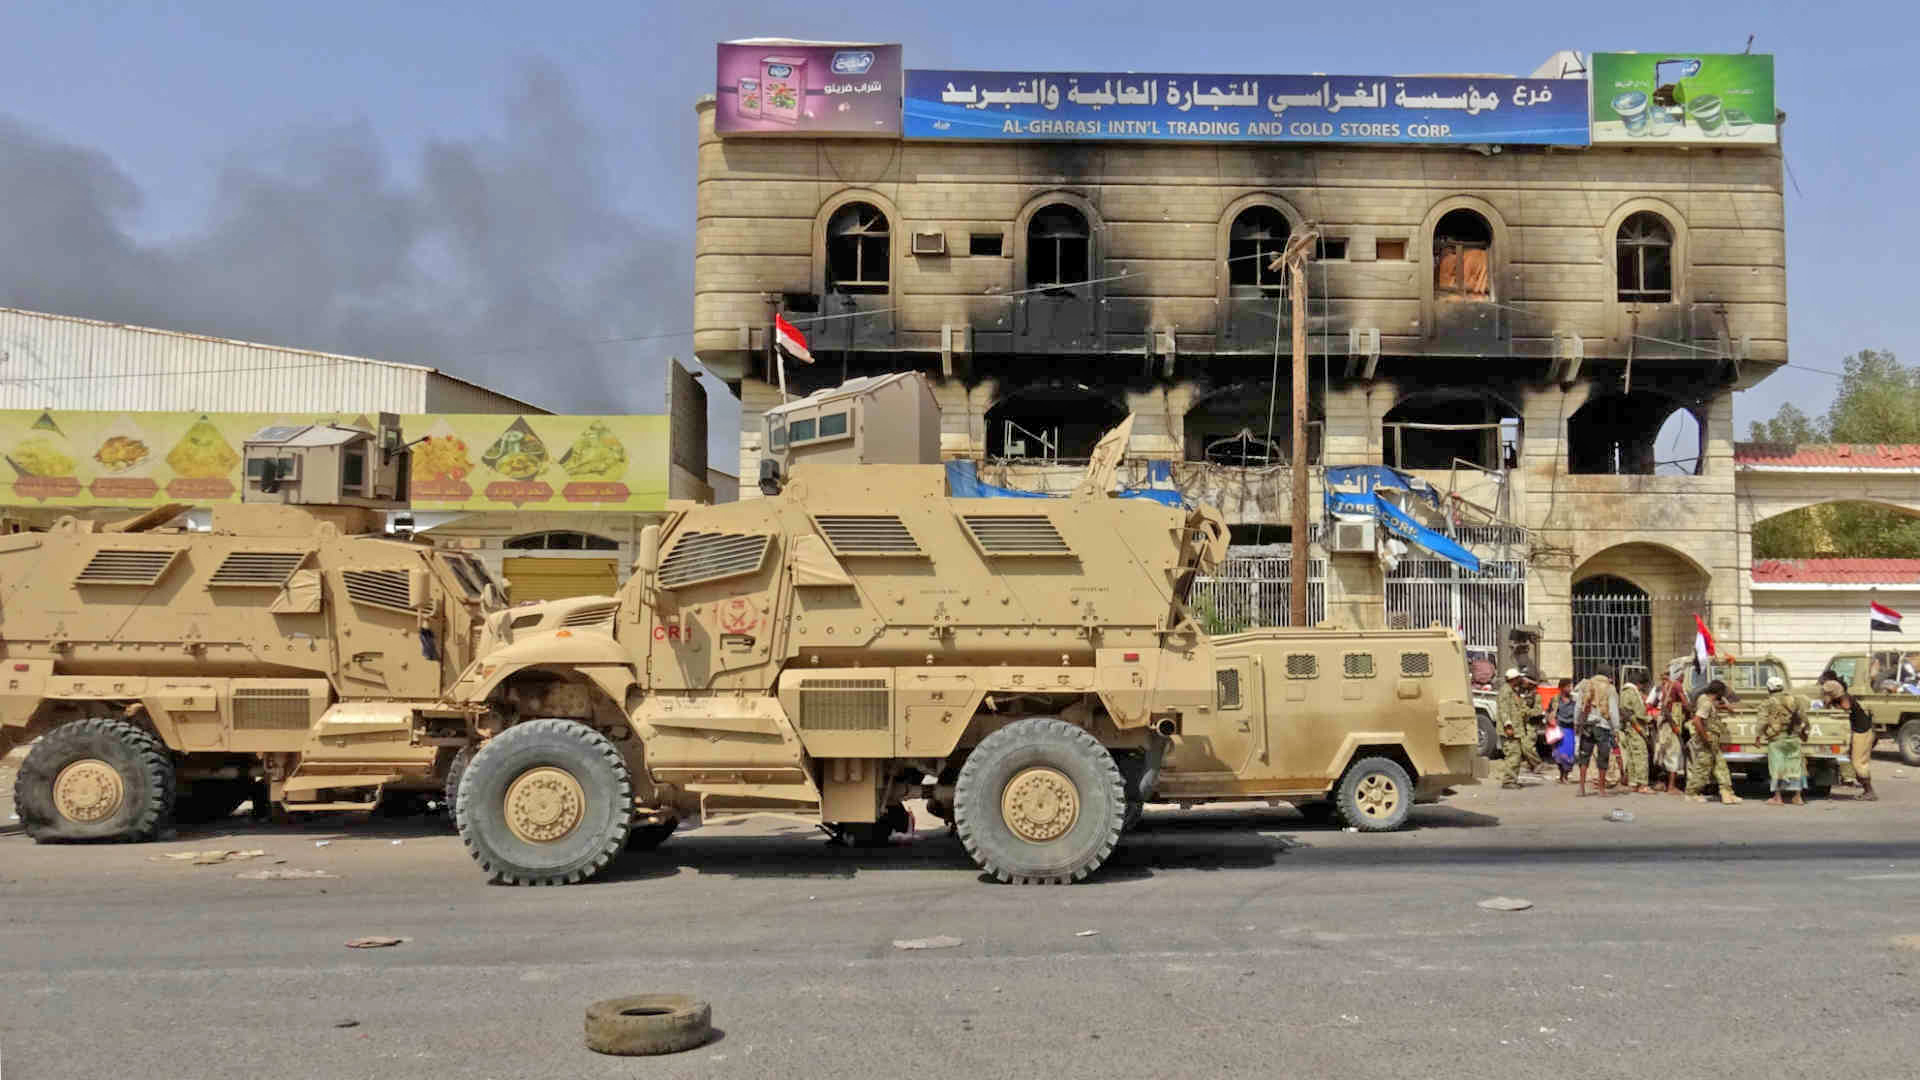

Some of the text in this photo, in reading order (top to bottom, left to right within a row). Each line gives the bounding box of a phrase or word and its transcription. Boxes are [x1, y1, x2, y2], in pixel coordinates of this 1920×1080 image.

[941, 78, 1553, 118] فرع مؤسسة الغراسي للتجارة العالمية والتبريد
[1002, 119, 1101, 134] AL-GHARASI
[1108, 119, 1161, 135] INTN'L
[1167, 120, 1240, 136] TRADING
[1247, 121, 1283, 136] AND
[1289, 121, 1334, 137] COLD
[1340, 122, 1401, 137] STORES
